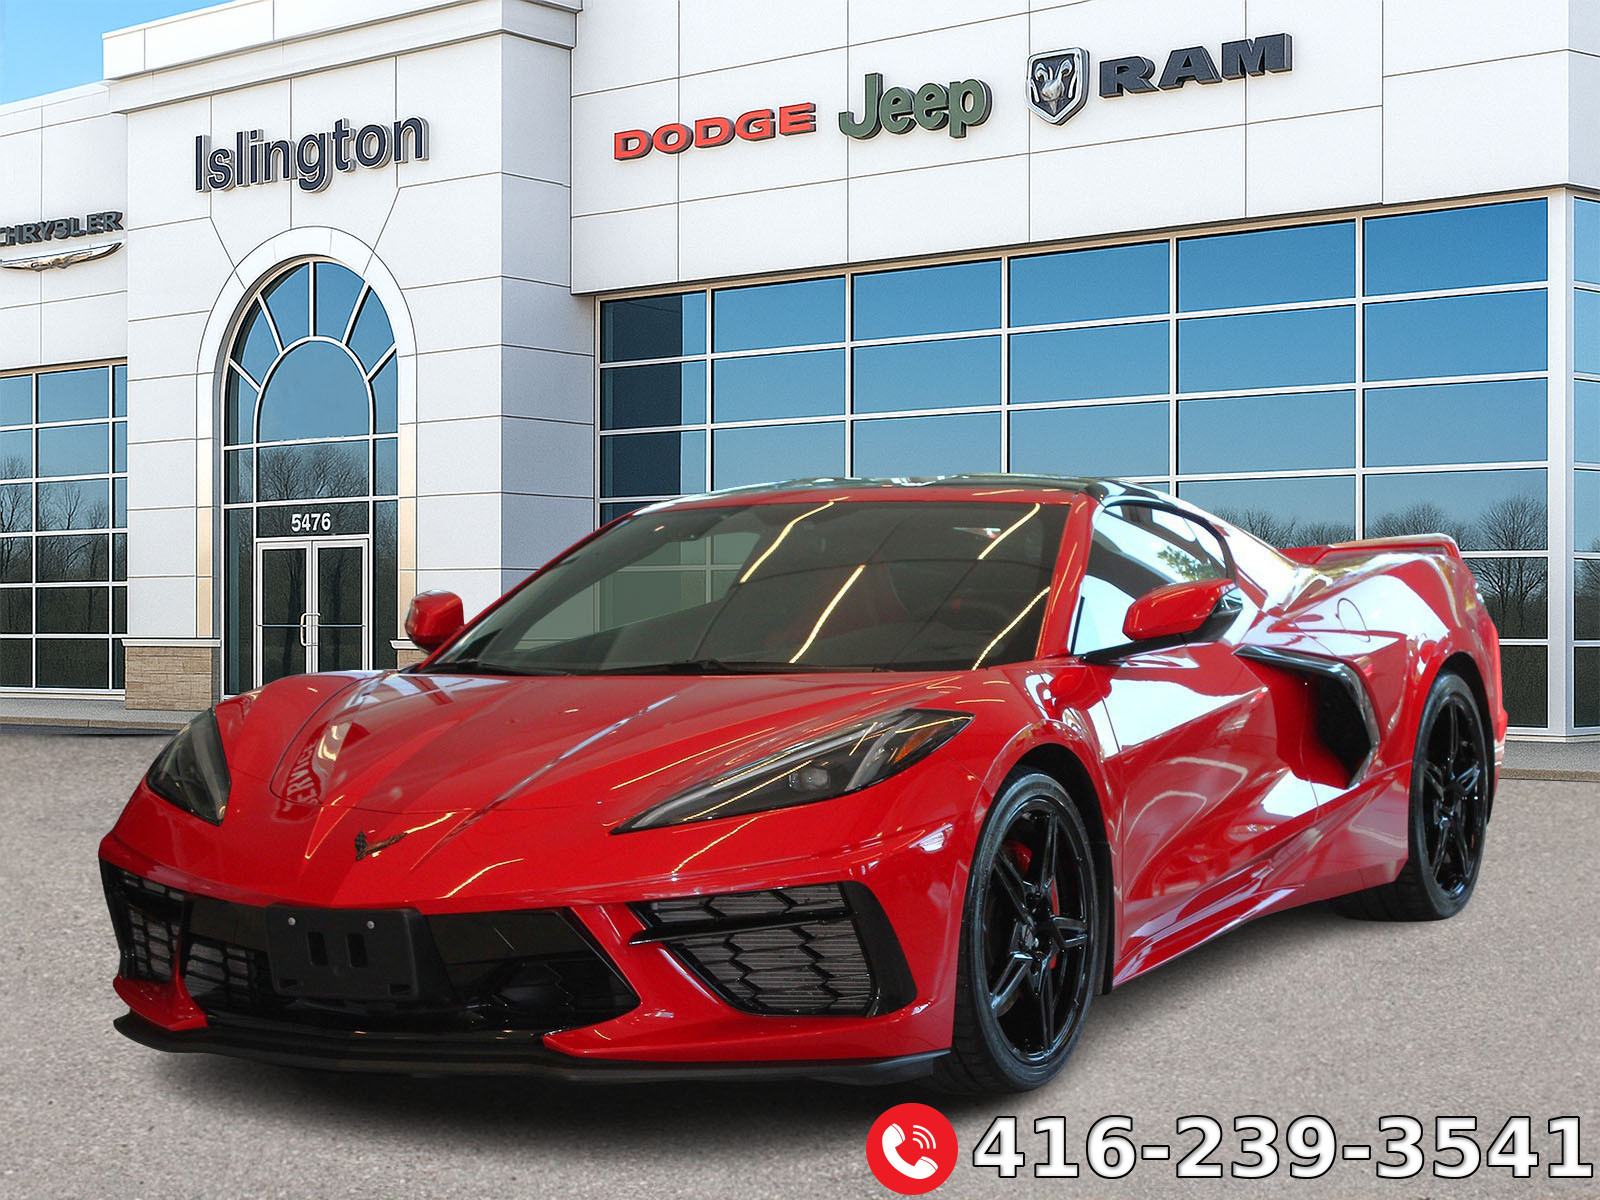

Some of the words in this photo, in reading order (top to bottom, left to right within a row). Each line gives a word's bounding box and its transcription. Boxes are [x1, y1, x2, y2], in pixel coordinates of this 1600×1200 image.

[1099, 33, 1292, 98] RAM
[613, 102, 816, 161] DODGE
[838, 72, 992, 140] Jeep
[195, 116, 430, 193] Islington
[291, 512, 331, 532] 5476
